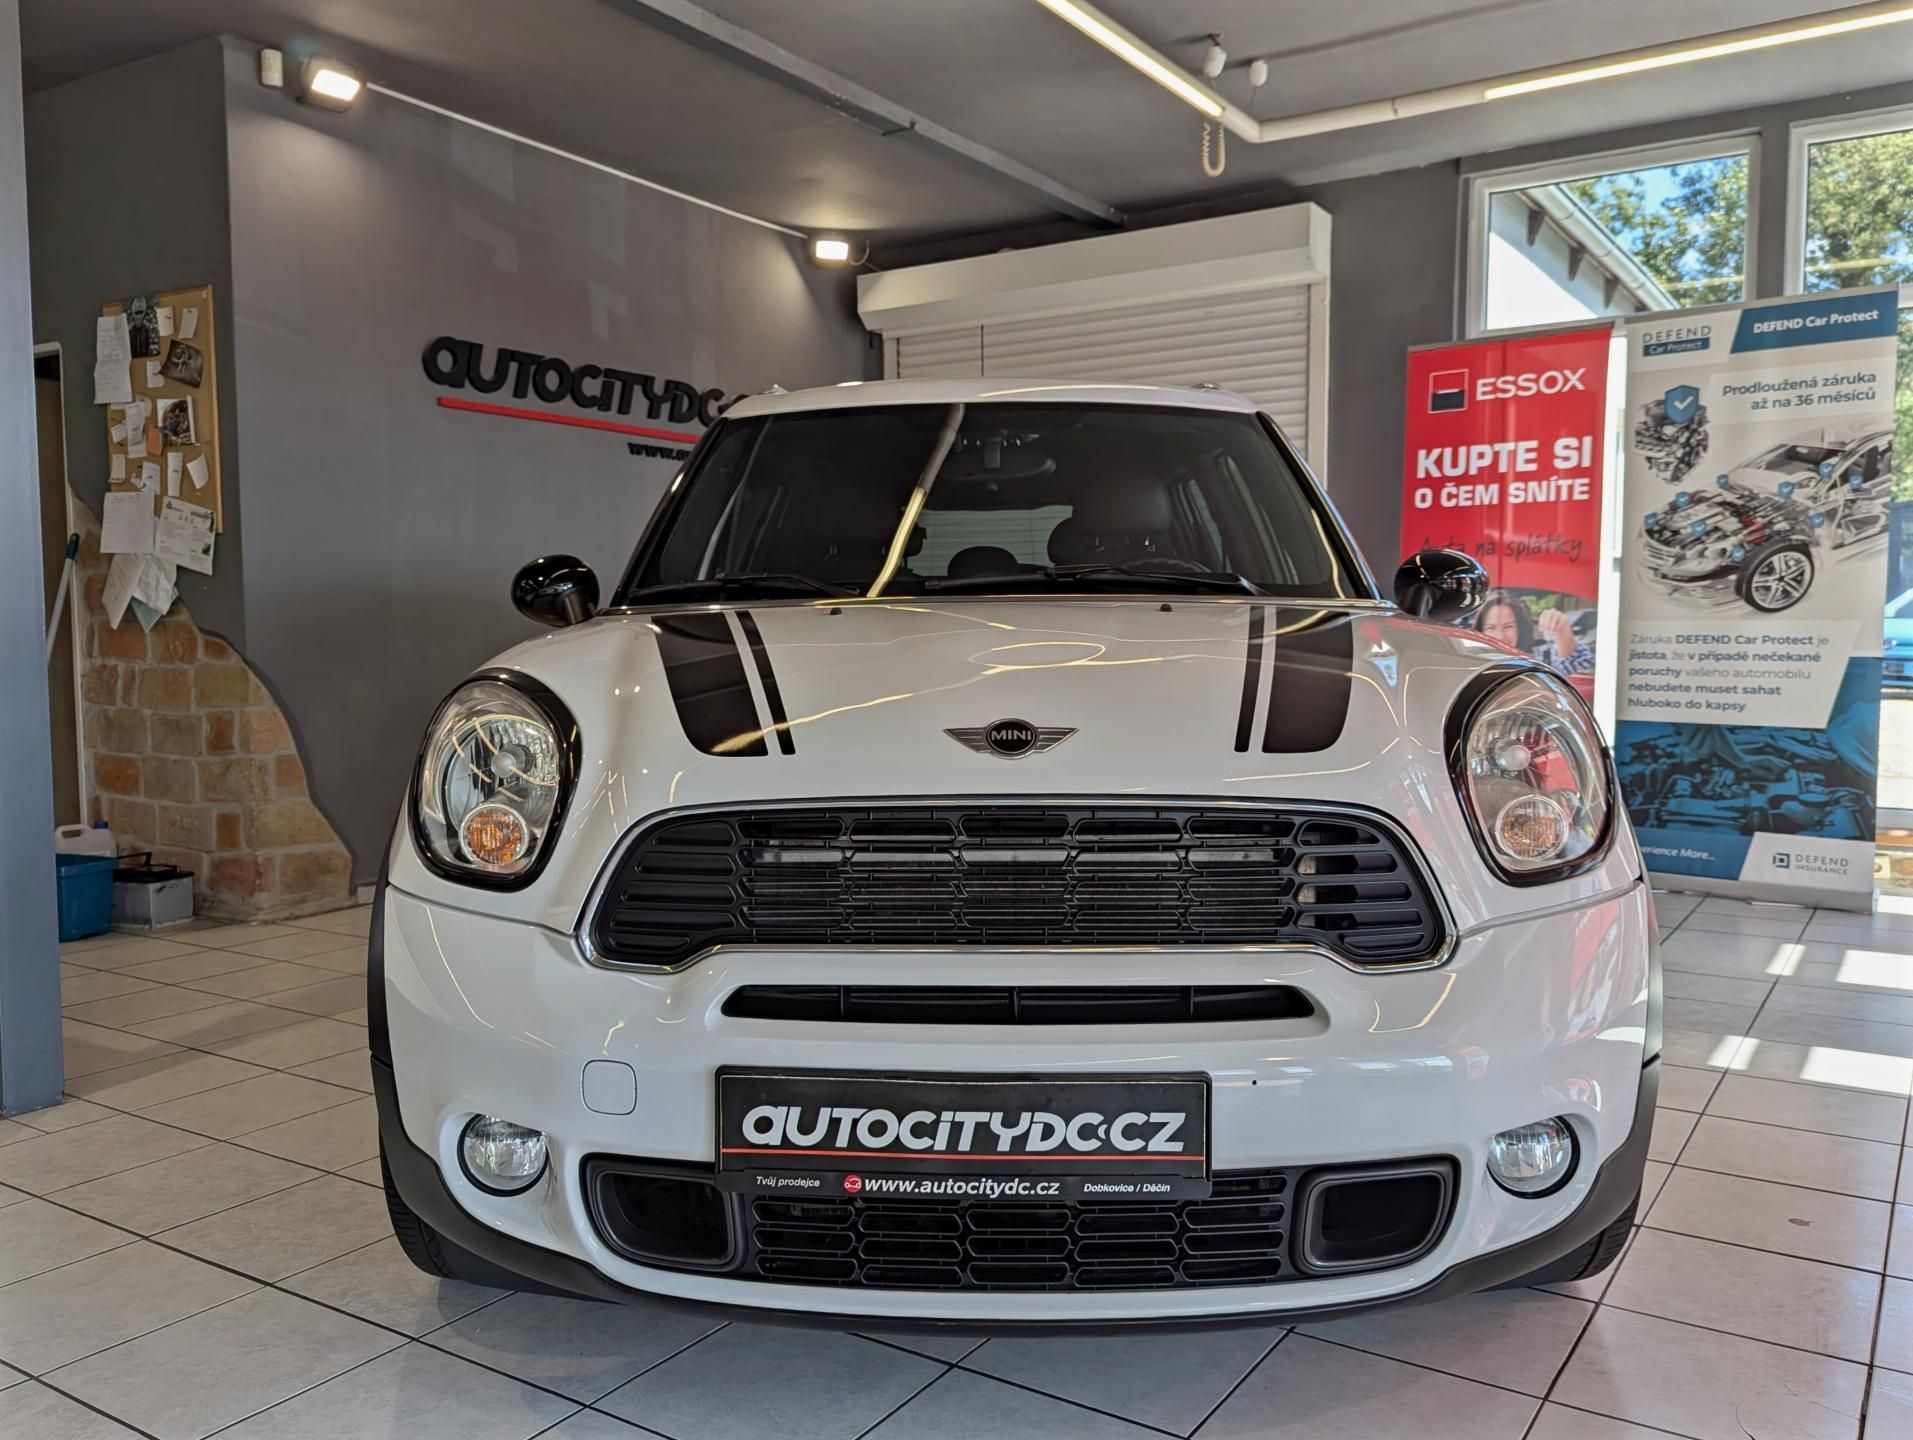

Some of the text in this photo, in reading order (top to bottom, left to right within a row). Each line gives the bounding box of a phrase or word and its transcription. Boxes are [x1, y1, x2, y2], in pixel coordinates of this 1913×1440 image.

[1753, 309, 1879, 334] DEFEND Car Protect
[1642, 326, 1712, 343] DEFEND
[1648, 341, 1702, 354] Car Protect
[1476, 368, 1586, 401] ESSOX
[1722, 370, 1877, 396] Prodloužená záruka
[1750, 386, 1876, 411] až na 36 měsíců
[1416, 436, 1593, 479] KUPTE SI
[1414, 476, 1590, 509] O ČEM SNÍTE
[1475, 543, 1497, 556] na
[1504, 532, 1582, 562] splátky
[1629, 633, 1829, 647] Záruka DEFEND Car Protect je
[1687, 652, 1696, 660] v
[1698, 650, 1749, 662] případě
[1752, 652, 1821, 662] nečekané
[1629, 666, 1811, 679] poruchy vašeho automobilu
[1628, 682, 1782, 695] nebudete muset sahat
[1628, 697, 1746, 713] hluboko do kapsy
[991, 730, 1032, 741] MINI
[1640, 846, 1679, 857] erience
[1795, 854, 1849, 867] DEFEND
[1795, 864, 1849, 876] INSURANCE
[755, 1175, 821, 1188] Tvůj prodejce
[864, 1177, 1061, 1199] www.autocitydc.cz
[1083, 1183, 1134, 1193] Dobkovice
[1142, 1183, 1171, 1193] Děčín
